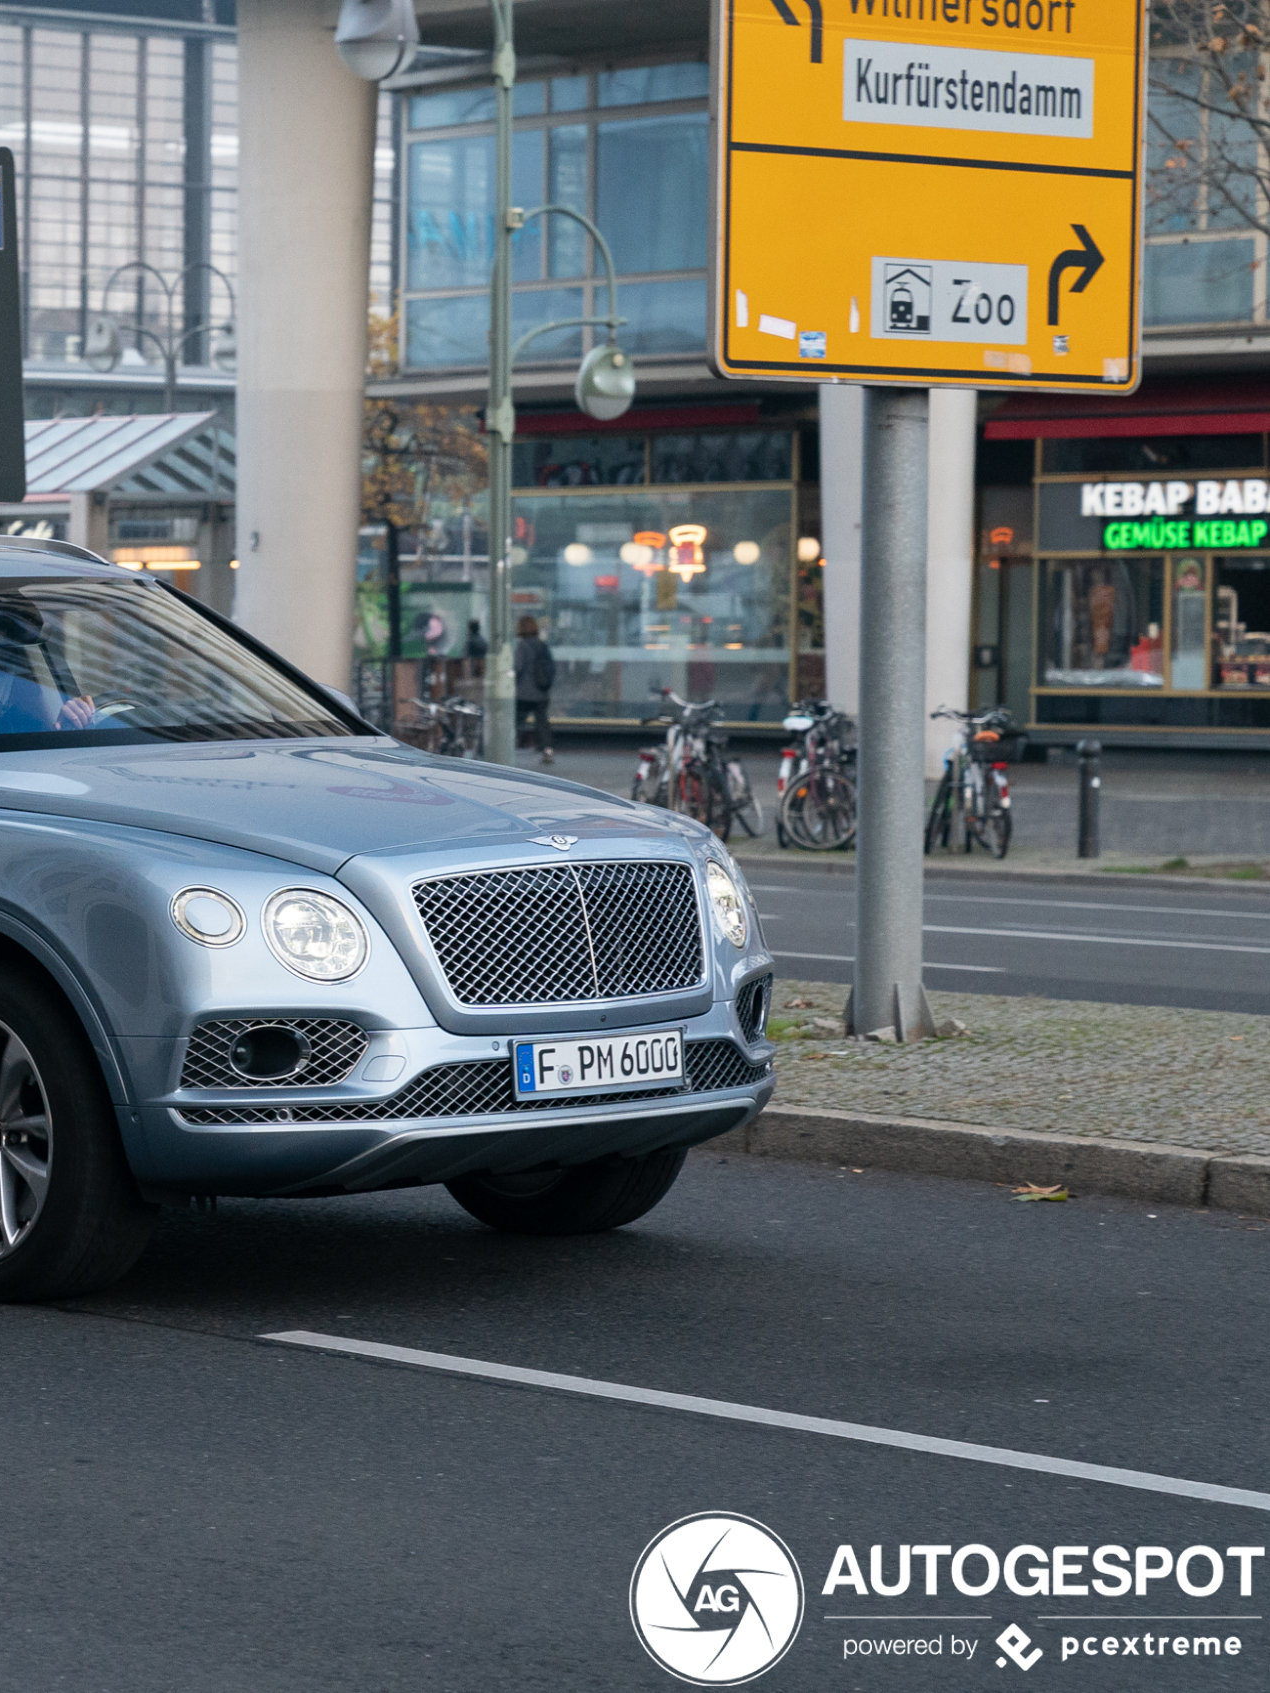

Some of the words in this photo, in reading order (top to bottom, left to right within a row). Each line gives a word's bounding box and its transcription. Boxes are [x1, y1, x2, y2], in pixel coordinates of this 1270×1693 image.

[856, 57, 1082, 119] Kurfürstendamm
[951, 278, 1015, 325] Zoo
[1081, 481, 1191, 516] KEBAP
[1196, 479, 1270, 515] BAB
[1104, 516, 1191, 549] GEMÜSE
[1193, 520, 1268, 548] KEBAP
[523, 1073, 531, 1084] D
[539, 1048, 556, 1084] F
